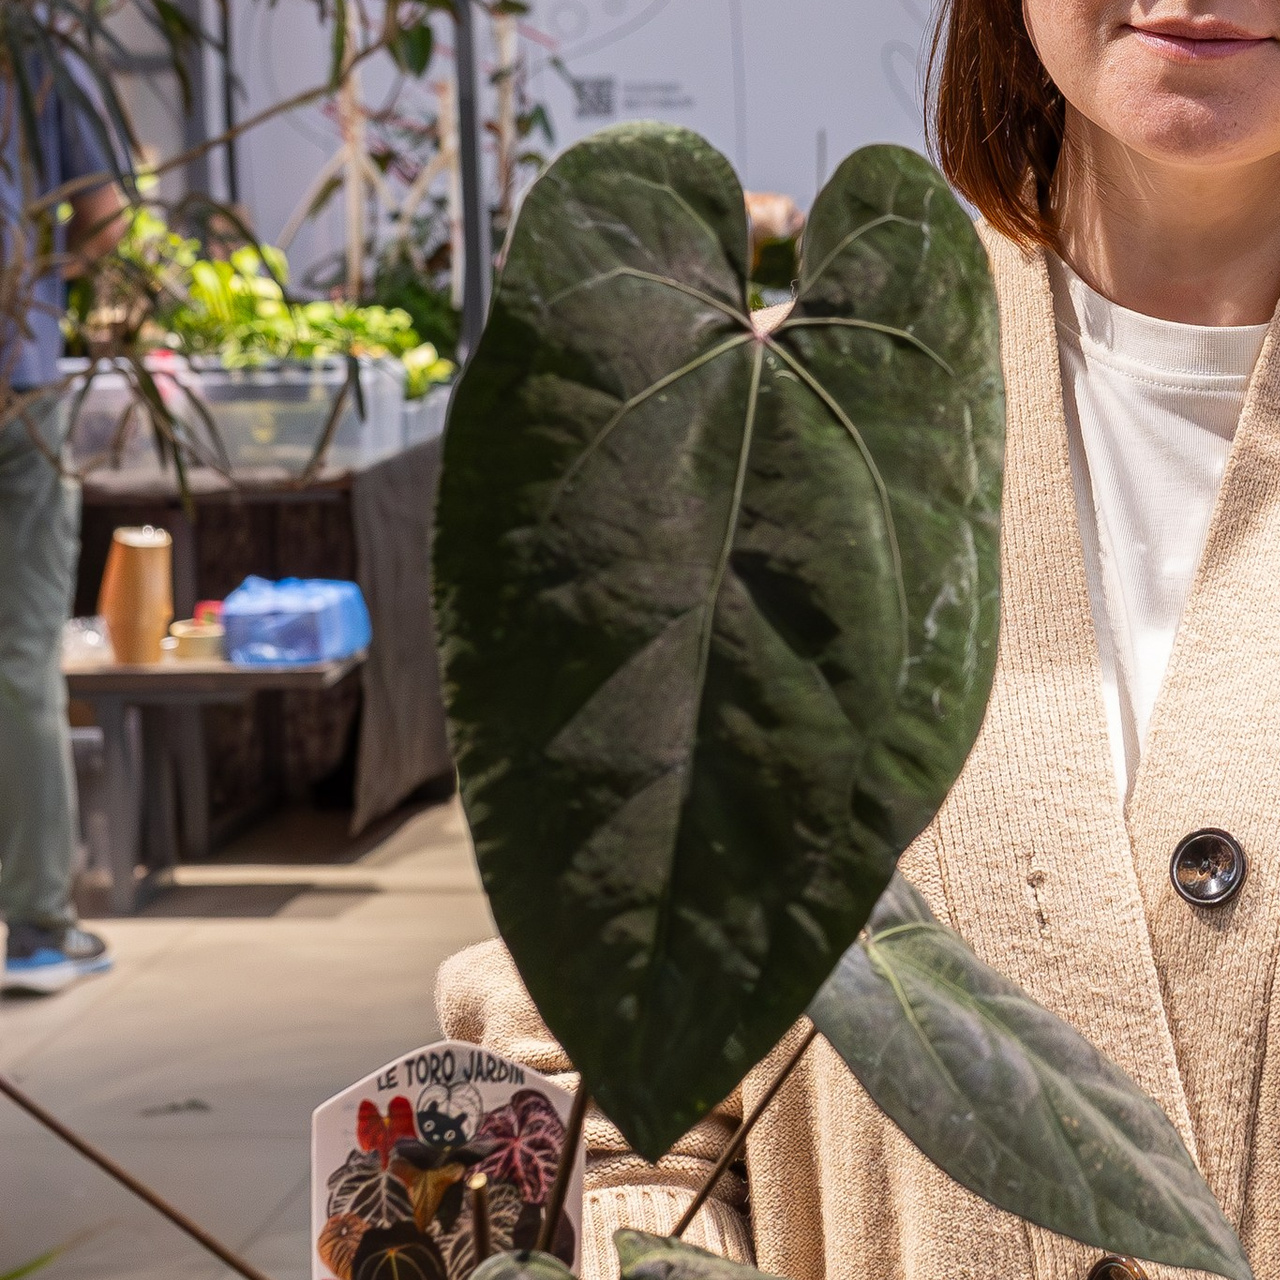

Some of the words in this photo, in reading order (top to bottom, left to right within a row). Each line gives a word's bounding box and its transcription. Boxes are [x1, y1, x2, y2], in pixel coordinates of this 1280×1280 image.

[376, 1067, 398, 1091] LE
[405, 1051, 453, 1086] TORO
[463, 1051, 526, 1085] JARDIN
